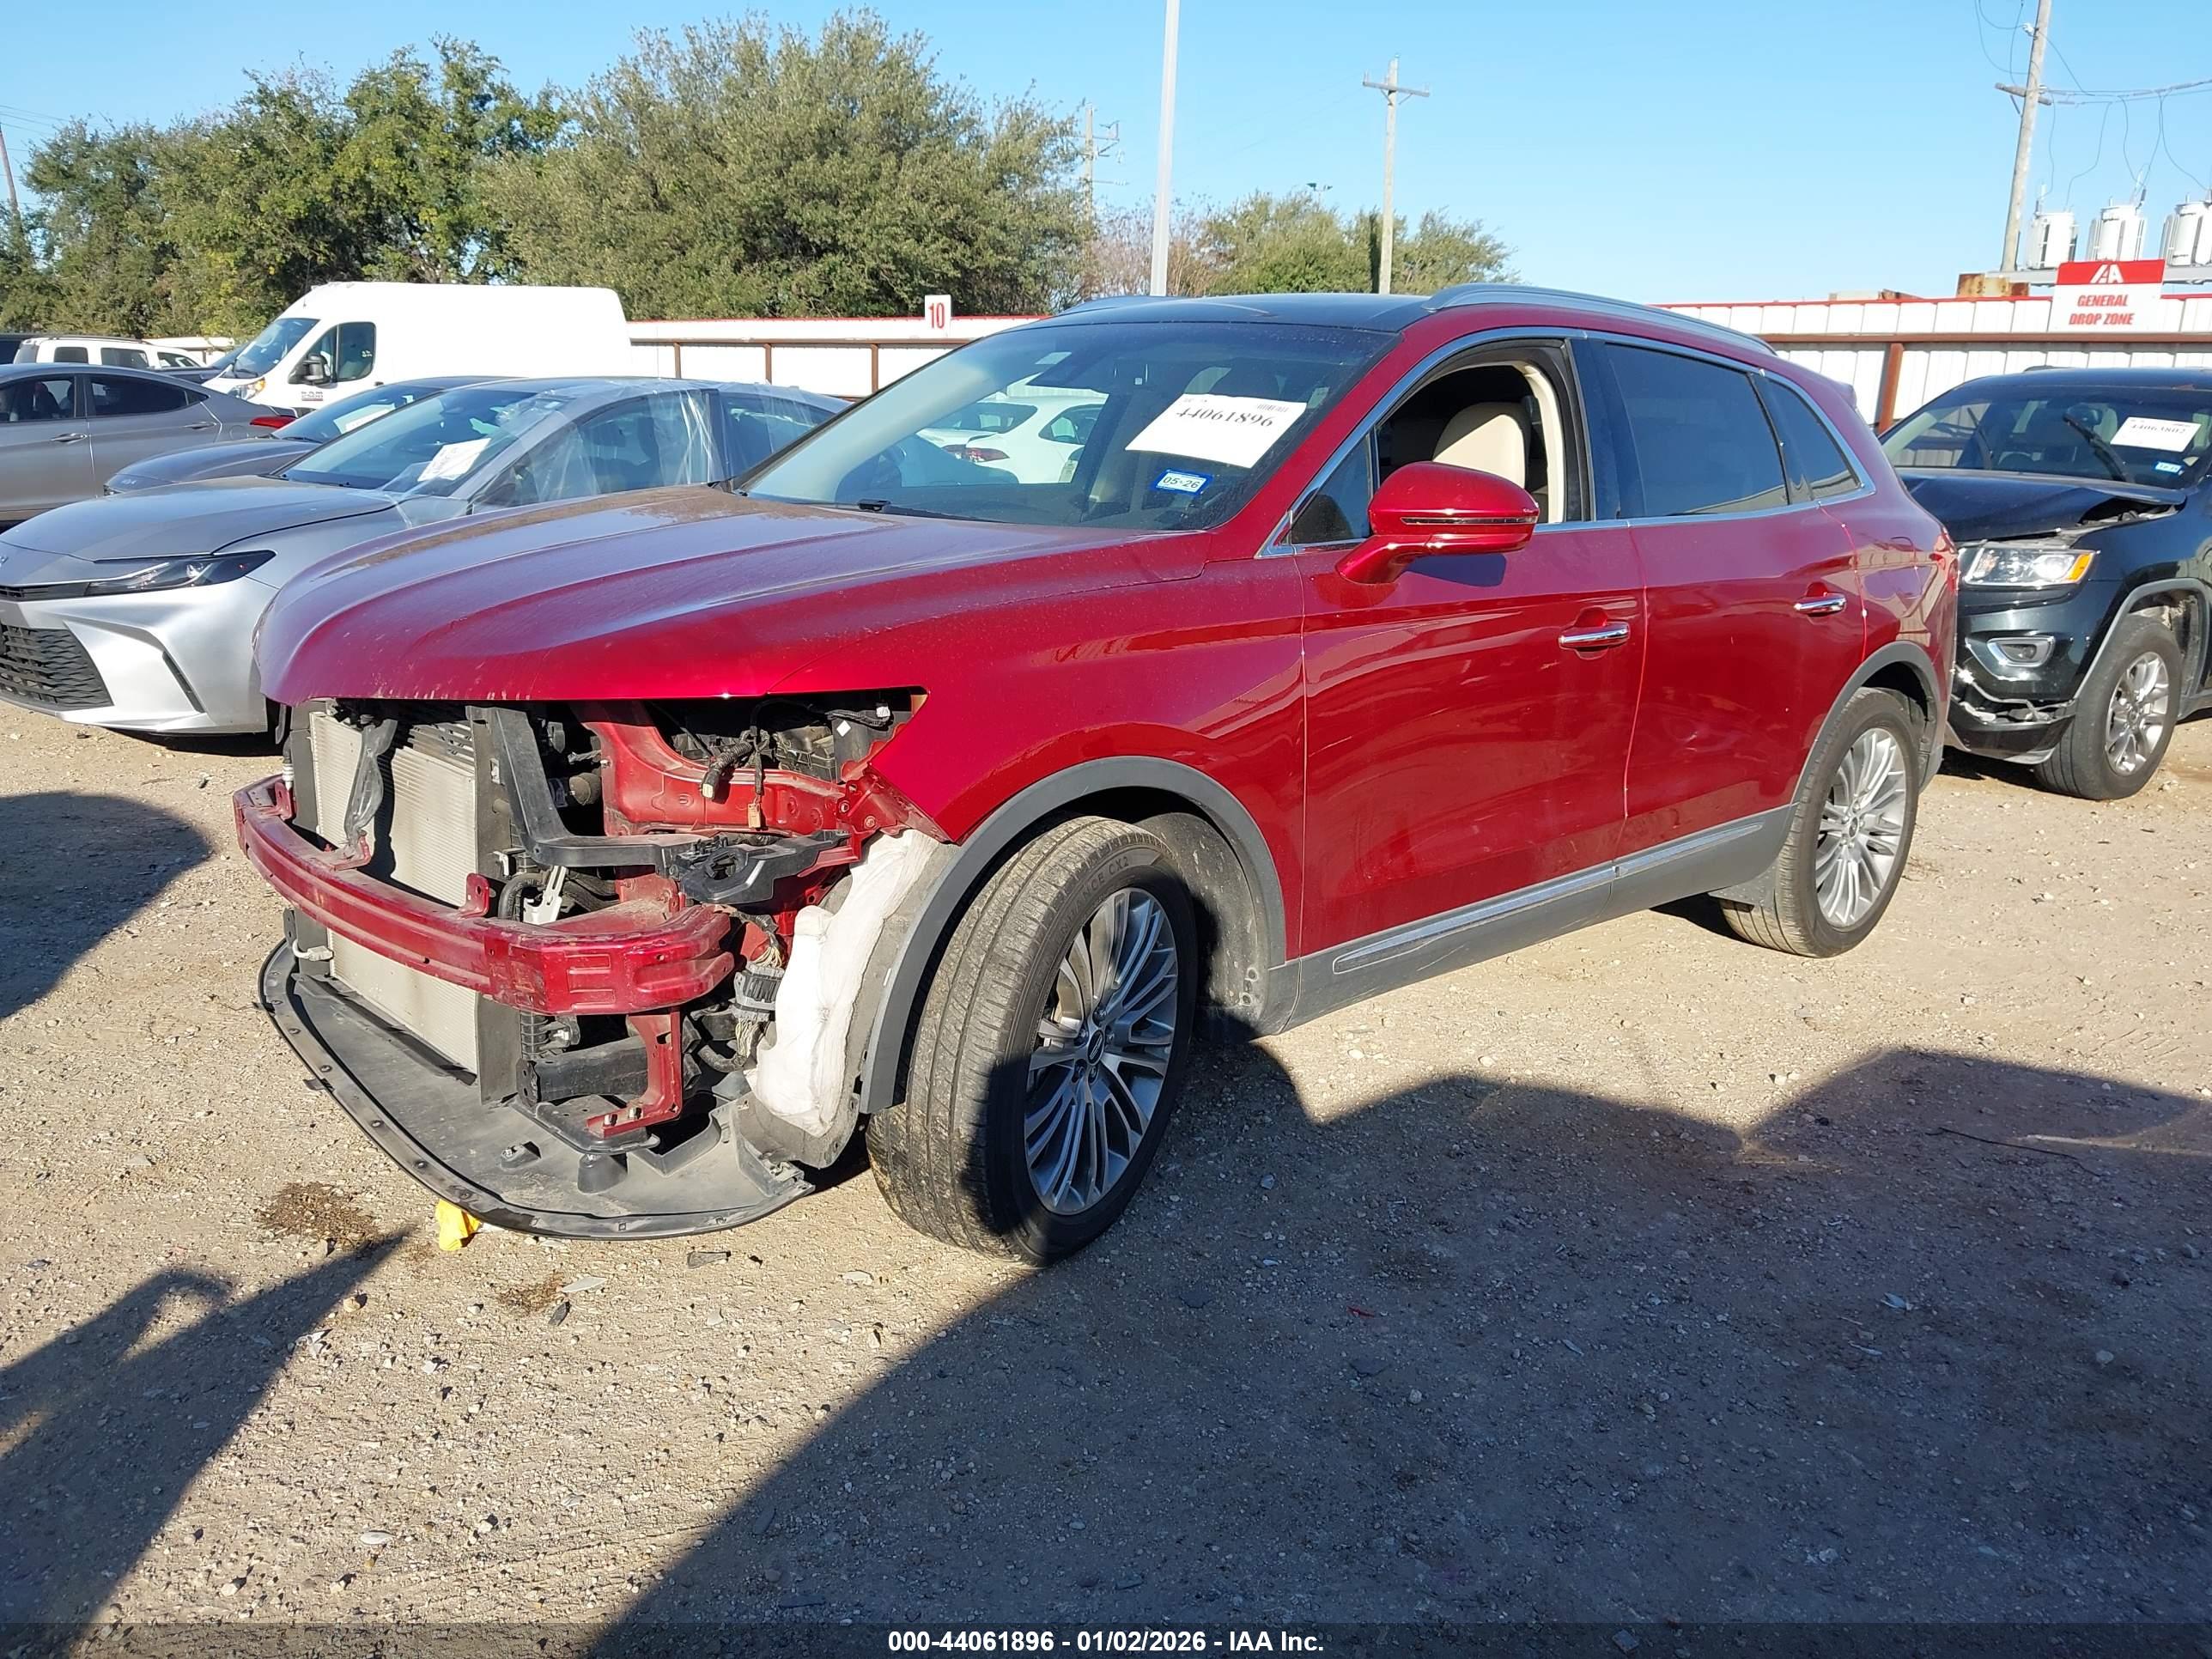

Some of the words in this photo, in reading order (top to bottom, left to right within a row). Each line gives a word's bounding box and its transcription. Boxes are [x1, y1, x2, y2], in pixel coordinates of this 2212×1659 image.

[2077, 295, 2129, 307] GENERAL
[928, 302, 945, 329] 10
[2069, 313, 2103, 325] DROP
[2103, 313, 2135, 325] ZONE
[1176, 407, 1275, 427] 44061896
